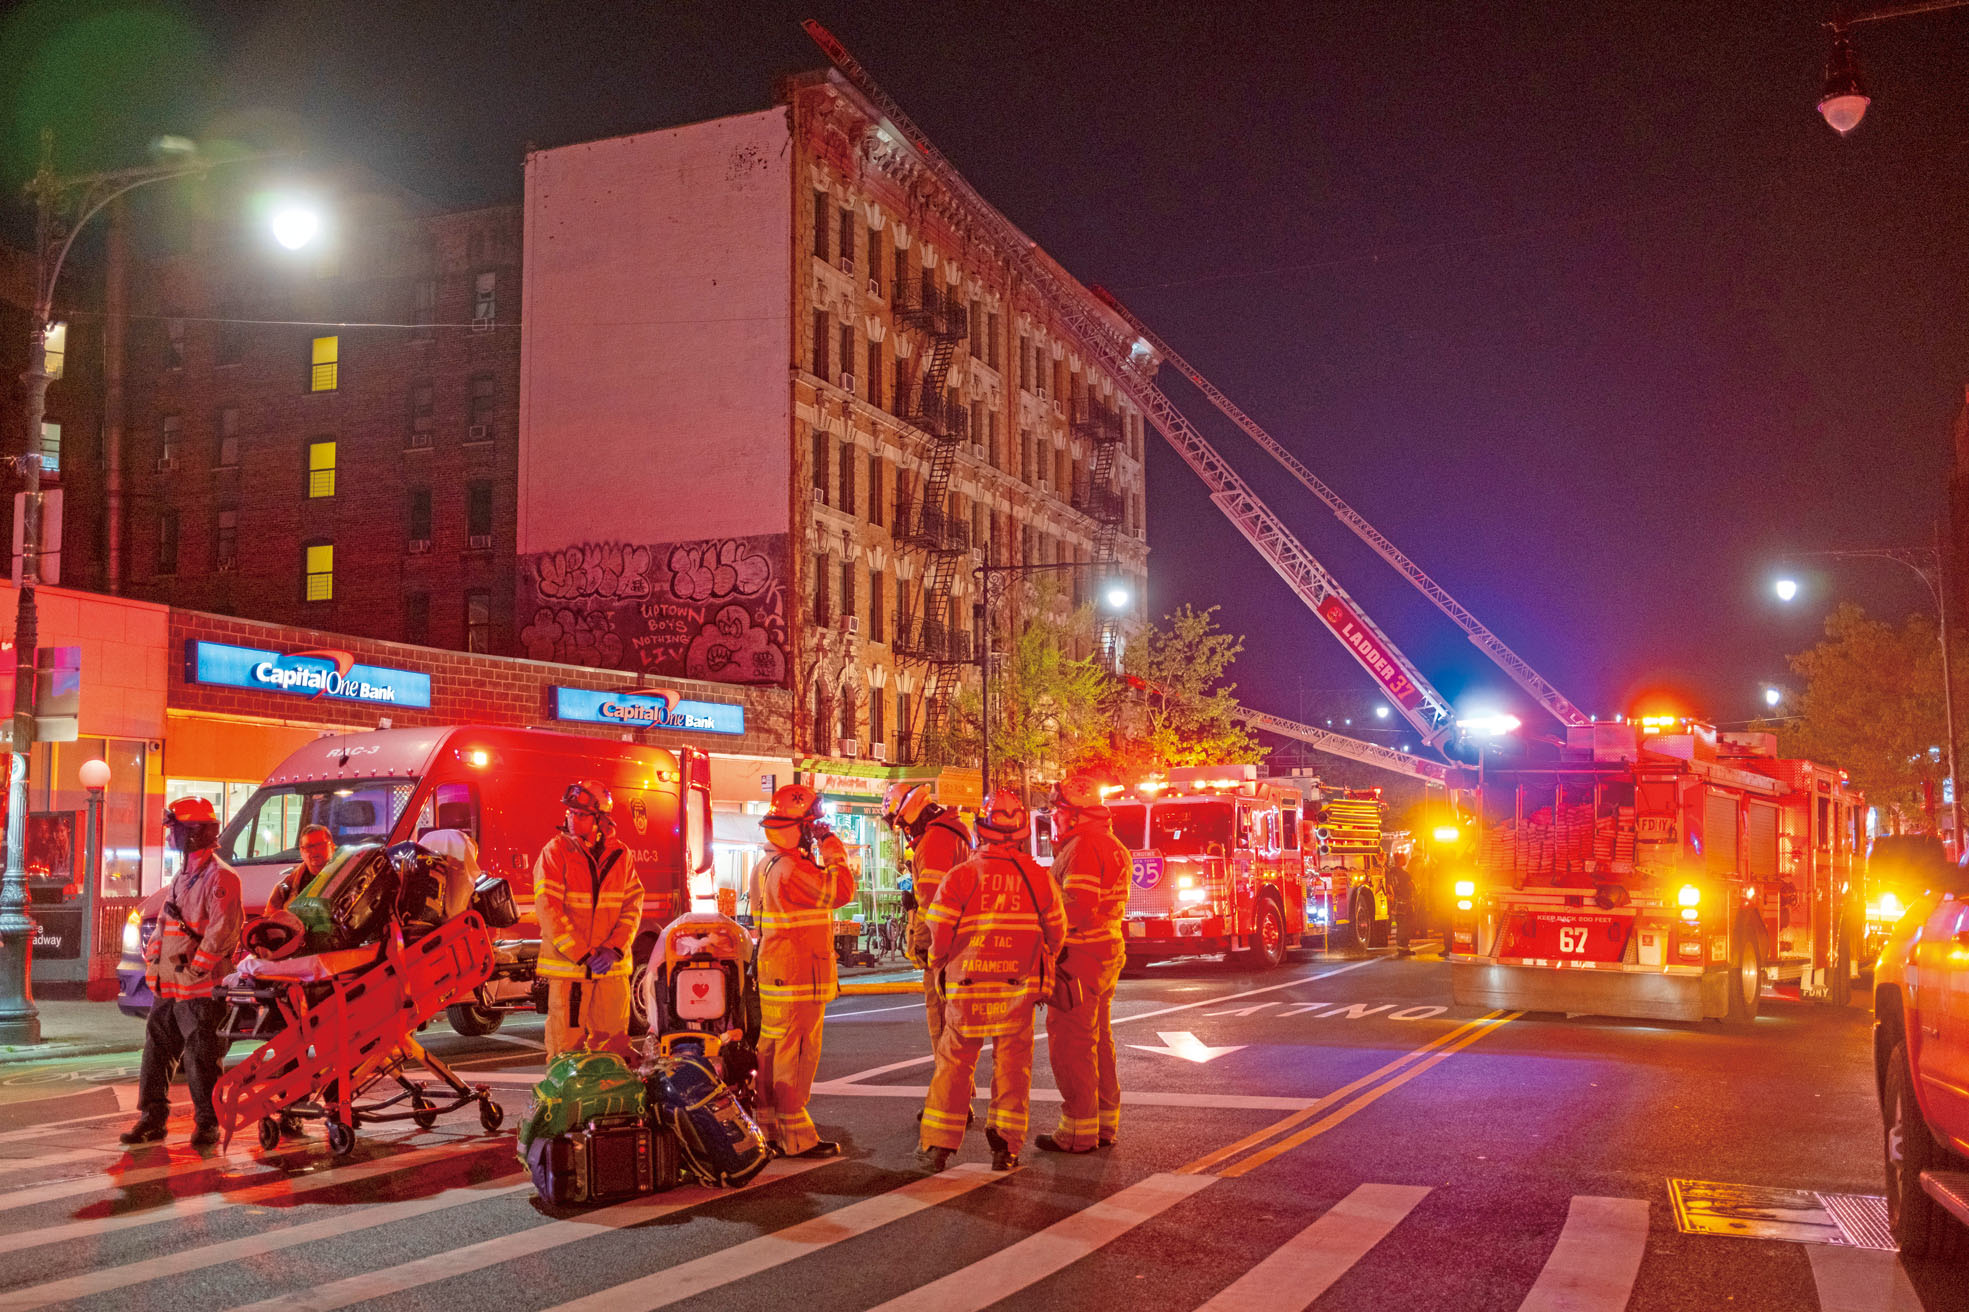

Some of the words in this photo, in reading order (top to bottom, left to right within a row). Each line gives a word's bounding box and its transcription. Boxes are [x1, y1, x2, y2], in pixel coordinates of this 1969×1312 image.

[1342, 623, 1395, 680] LADDER
[1389, 675, 1415, 700] 37
[360, 683, 395, 701] Bank
[686, 715, 715, 729] Bank
[326, 745, 380, 758] RAC-3
[631, 849, 658, 862] RAC-3
[1133, 863, 1159, 884] 95
[981, 874, 1022, 893] FDNY
[981, 894, 1021, 911] EMS
[1537, 914, 1556, 922] KEEP
[33, 934, 62, 948] adway
[968, 936, 987, 948] HAZ
[994, 936, 1013, 948] TAC
[1559, 926, 1588, 953] 67
[962, 960, 1020, 973] PARAMEDIC
[972, 1002, 1007, 1015] PEDRO
